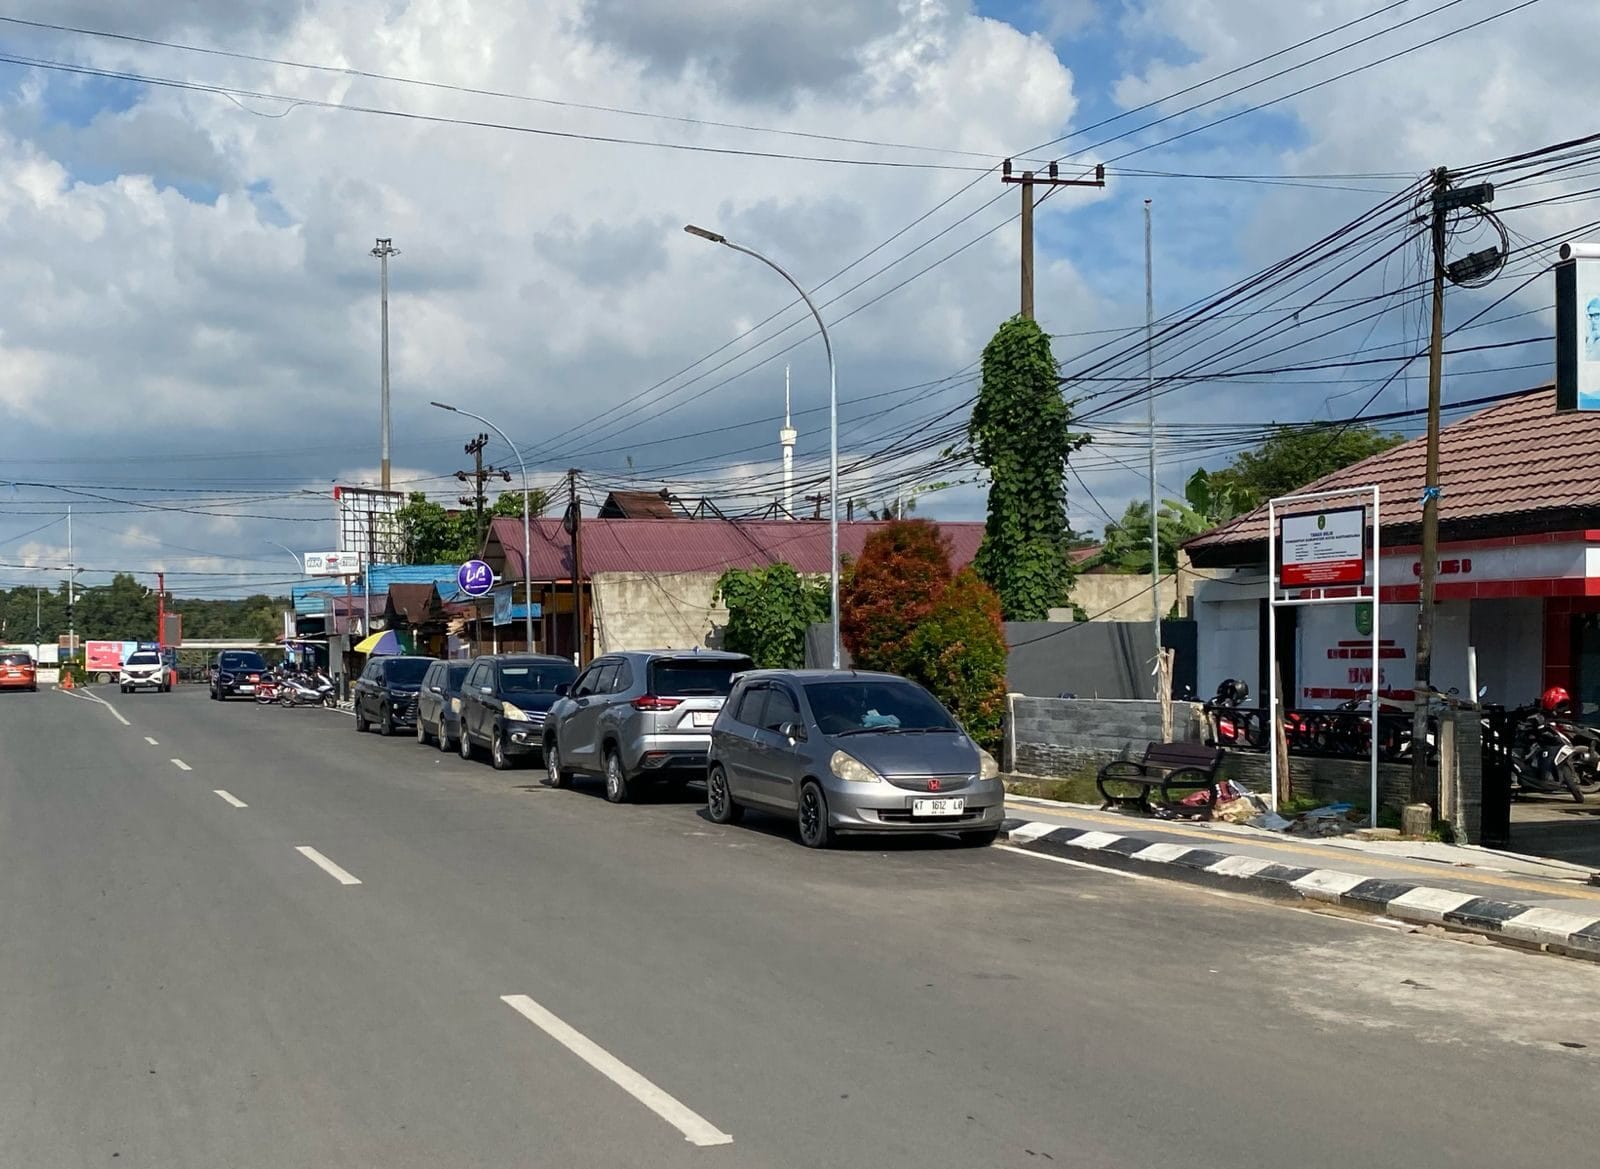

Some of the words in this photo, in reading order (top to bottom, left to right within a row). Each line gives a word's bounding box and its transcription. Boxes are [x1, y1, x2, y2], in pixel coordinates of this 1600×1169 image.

[466, 565, 486, 583] LA
[914, 800, 923, 810] KT
[931, 800, 946, 810] 1612
